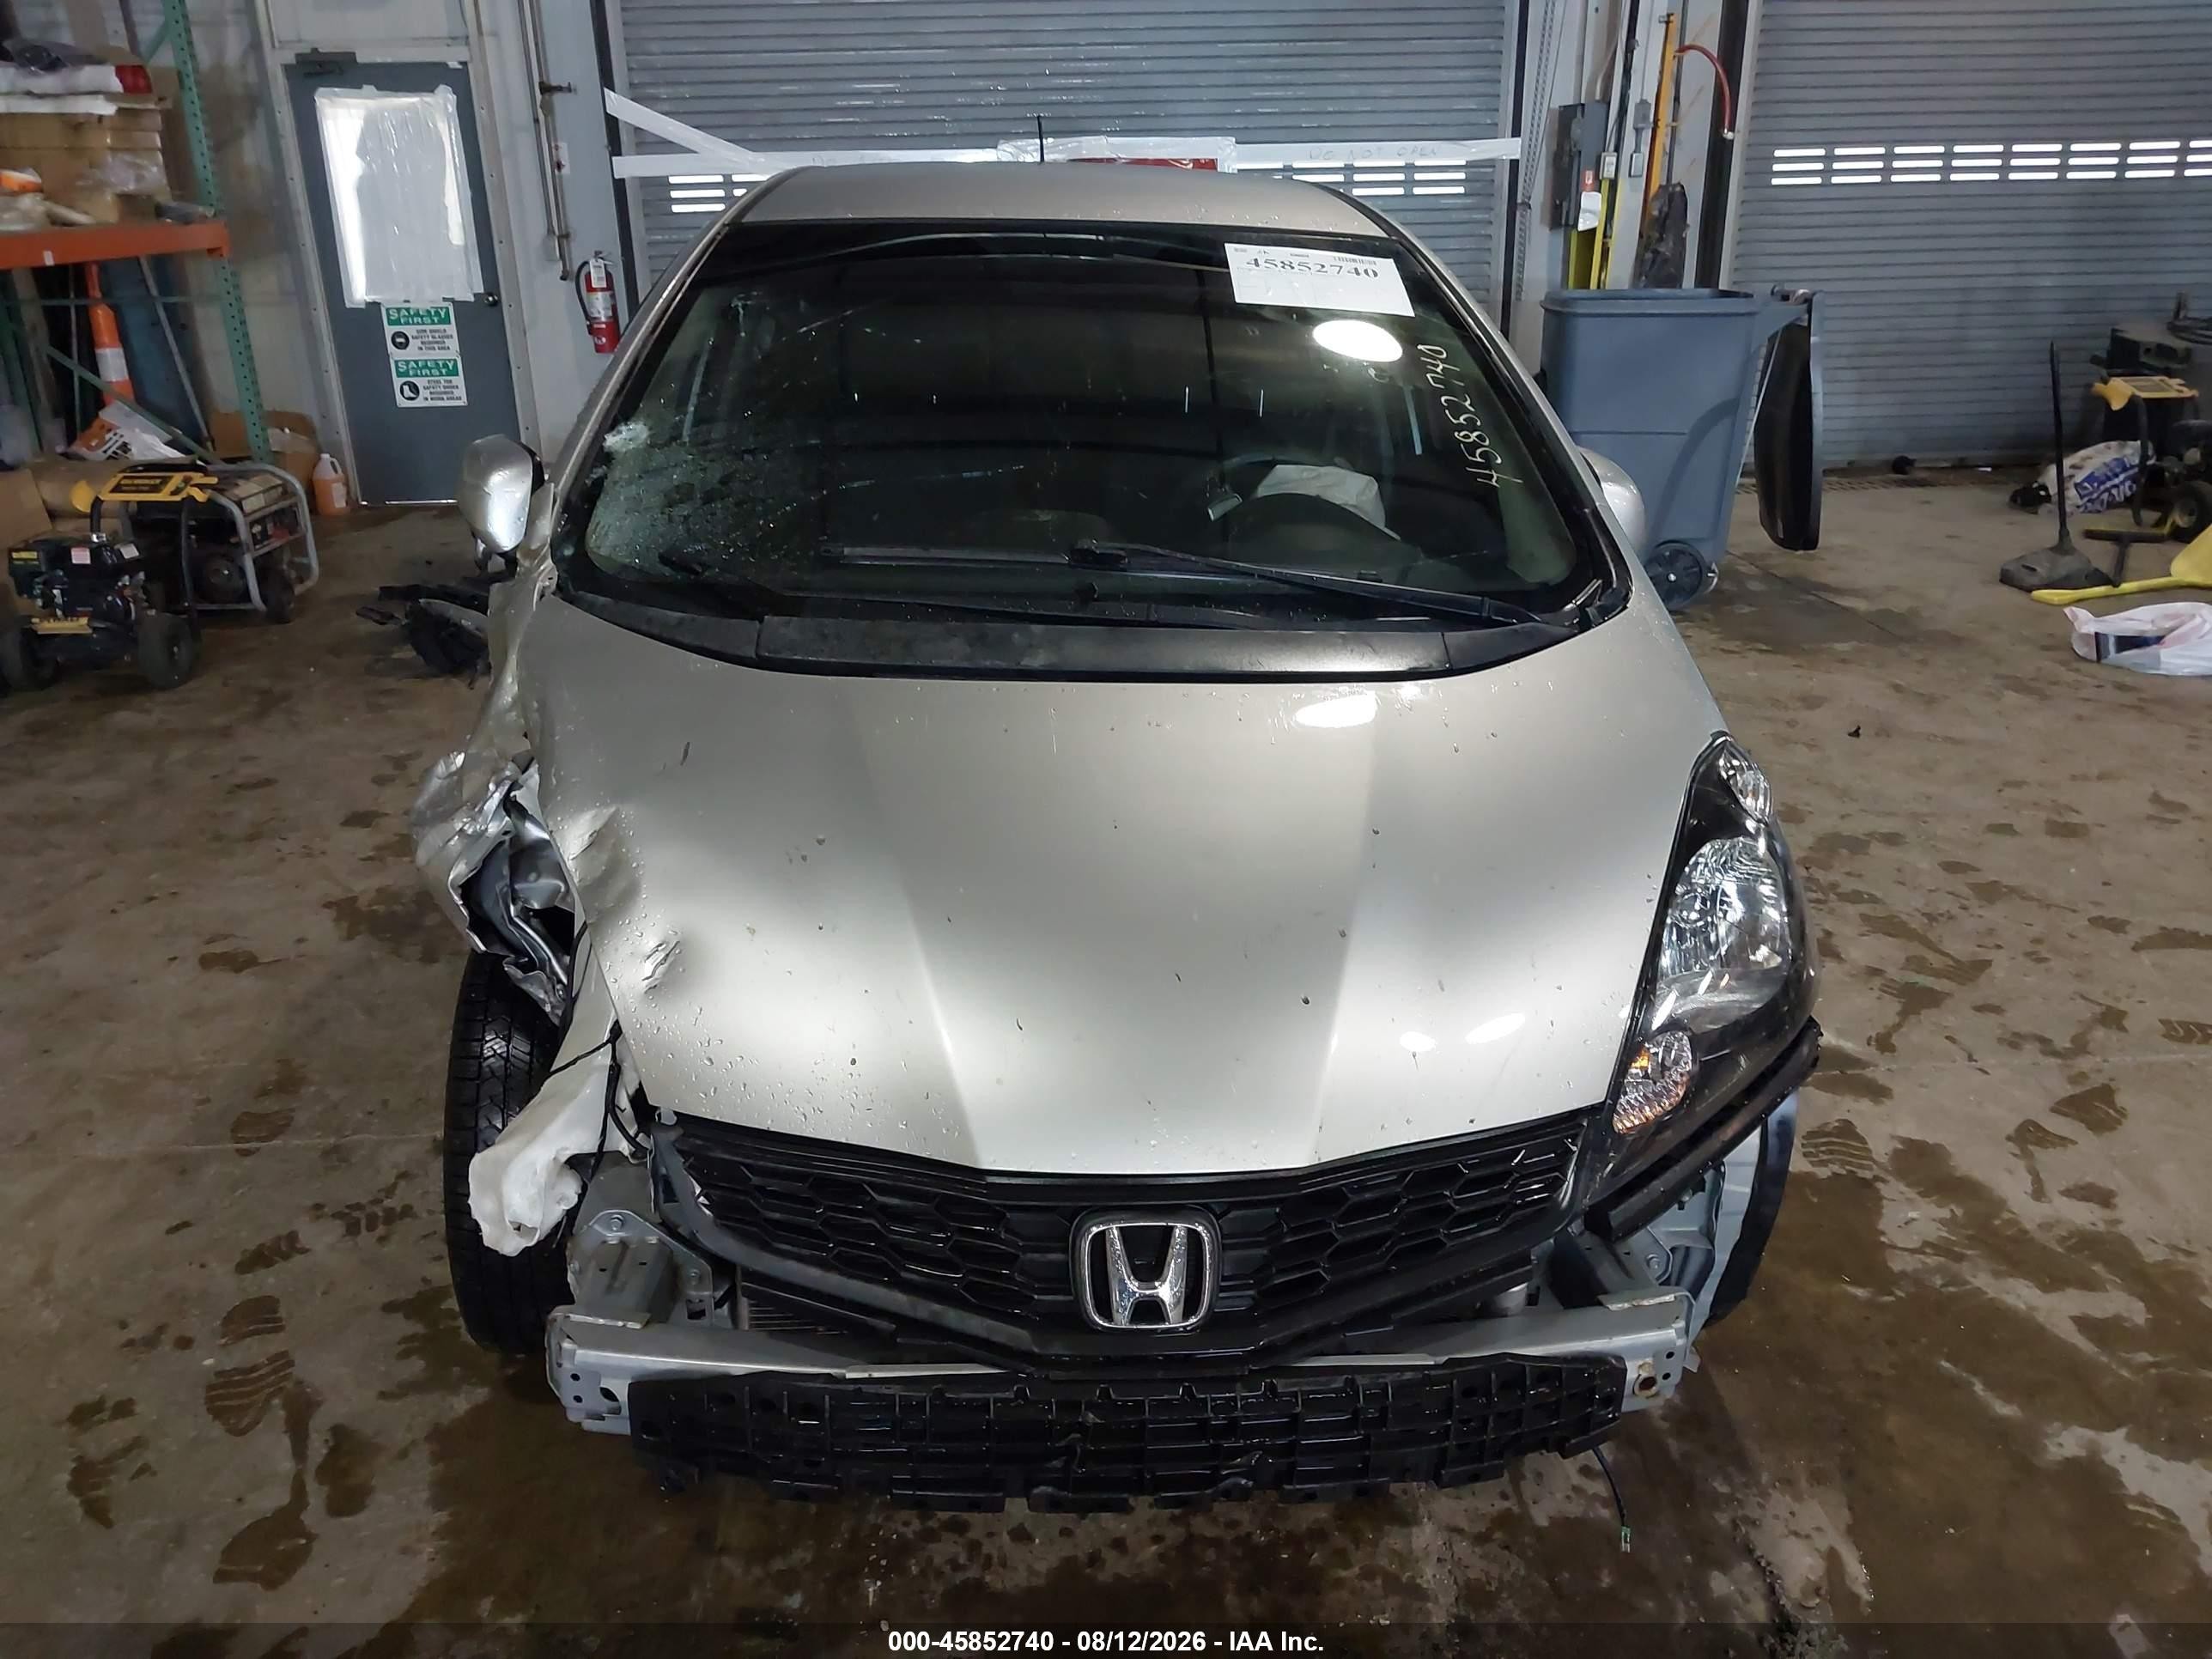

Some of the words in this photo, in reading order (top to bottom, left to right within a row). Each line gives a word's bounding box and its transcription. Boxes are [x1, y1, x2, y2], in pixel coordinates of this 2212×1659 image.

[1347, 147, 1385, 160] NOT
[1396, 144, 1442, 157] OPEN
[1246, 257, 1379, 279] 45852740
[389, 308, 446, 319] SAFETY
[400, 316, 441, 325] FIRST
[398, 361, 454, 372] SAFETY
[1418, 344, 1523, 488] 45852740
